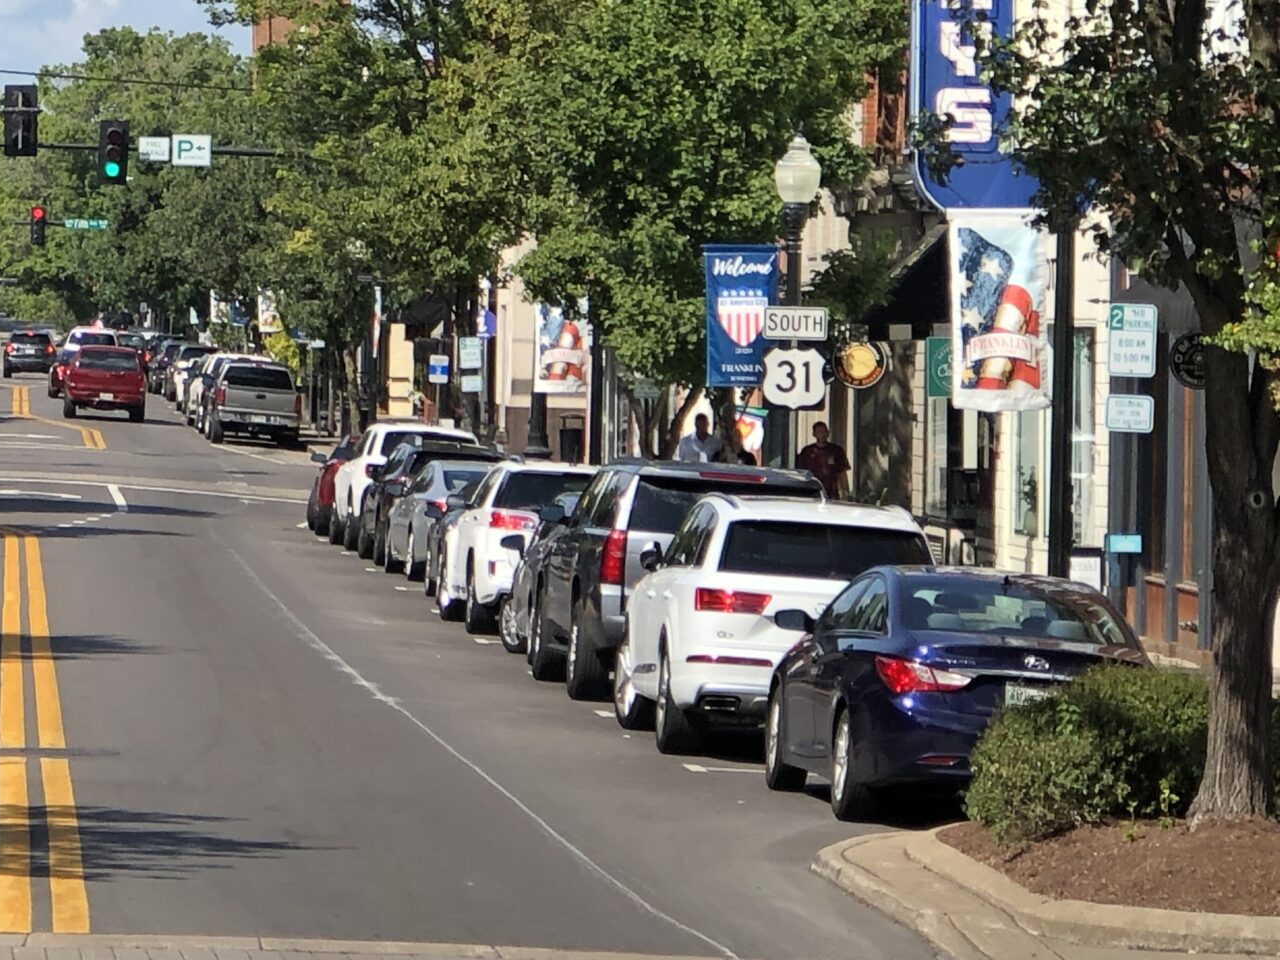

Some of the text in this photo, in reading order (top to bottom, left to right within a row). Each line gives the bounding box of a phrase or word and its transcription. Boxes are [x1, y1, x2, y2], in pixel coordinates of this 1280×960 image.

[177, 140, 194, 160] P
[713, 255, 775, 277] Welcome
[767, 312, 823, 333] SOUTH
[1111, 309, 1124, 328] 2
[1125, 319, 1153, 329] PARKING
[972, 336, 1030, 353] FRANKLIN
[1136, 339, 1146, 348] AM
[1140, 354, 1150, 363] PM
[721, 363, 764, 373] FRANKLIN
[774, 359, 811, 393] 31
